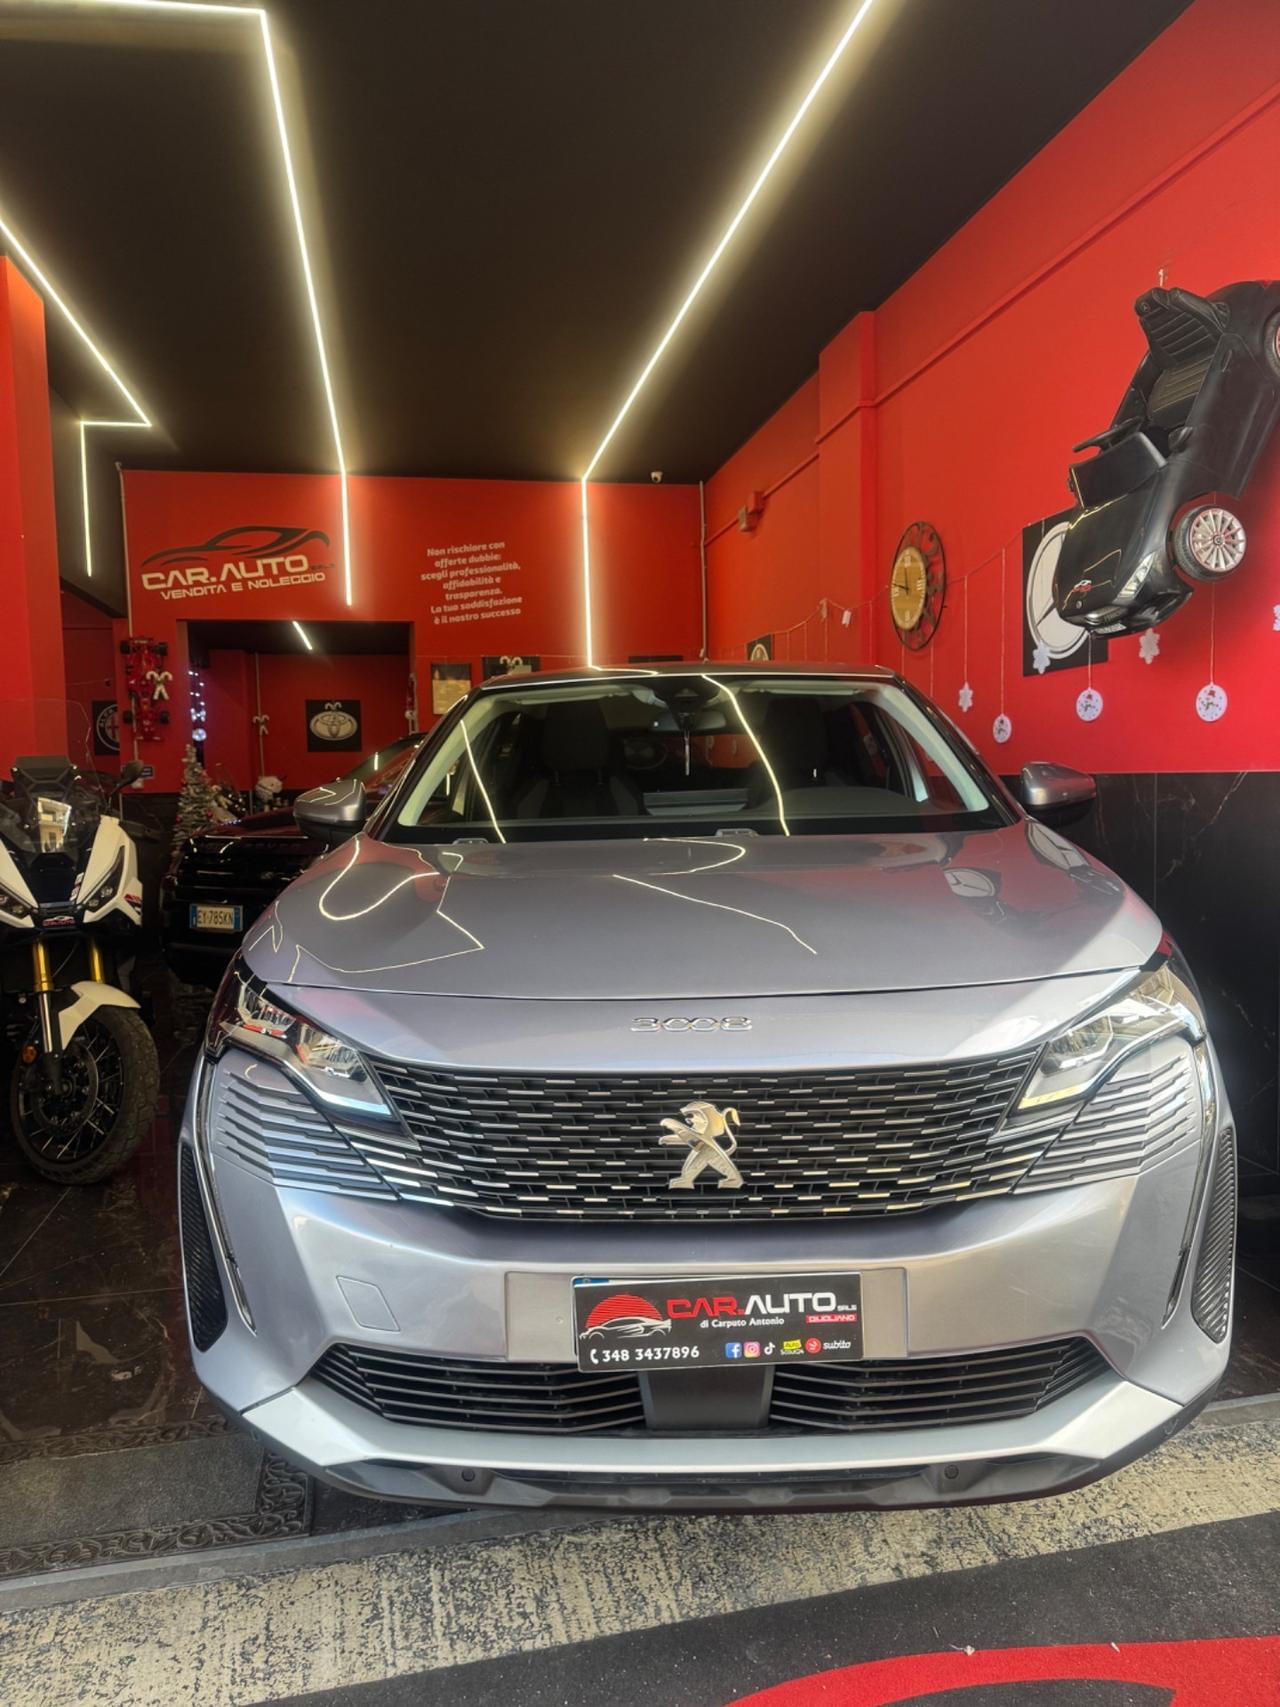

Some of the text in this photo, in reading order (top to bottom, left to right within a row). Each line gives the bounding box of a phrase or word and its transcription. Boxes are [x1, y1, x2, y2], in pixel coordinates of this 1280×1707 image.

[427, 541, 505, 556] Non rischiare con
[434, 557, 467, 568] offerte
[421, 570, 448, 581] scegli
[160, 572, 326, 600] VENDITA E NOLEGGIO
[443, 576, 494, 590] affidabilità
[445, 587, 503, 601] trasparenza.
[430, 596, 522, 614] La tua soddisfazione
[434, 608, 521, 625] è il nostro successo
[630, 1016, 753, 1032] 3008
[700, 1316, 785, 1328] di Carputo Antonio
[823, 1339, 852, 1350] subito
[602, 1345, 700, 1362] 348 3437896
